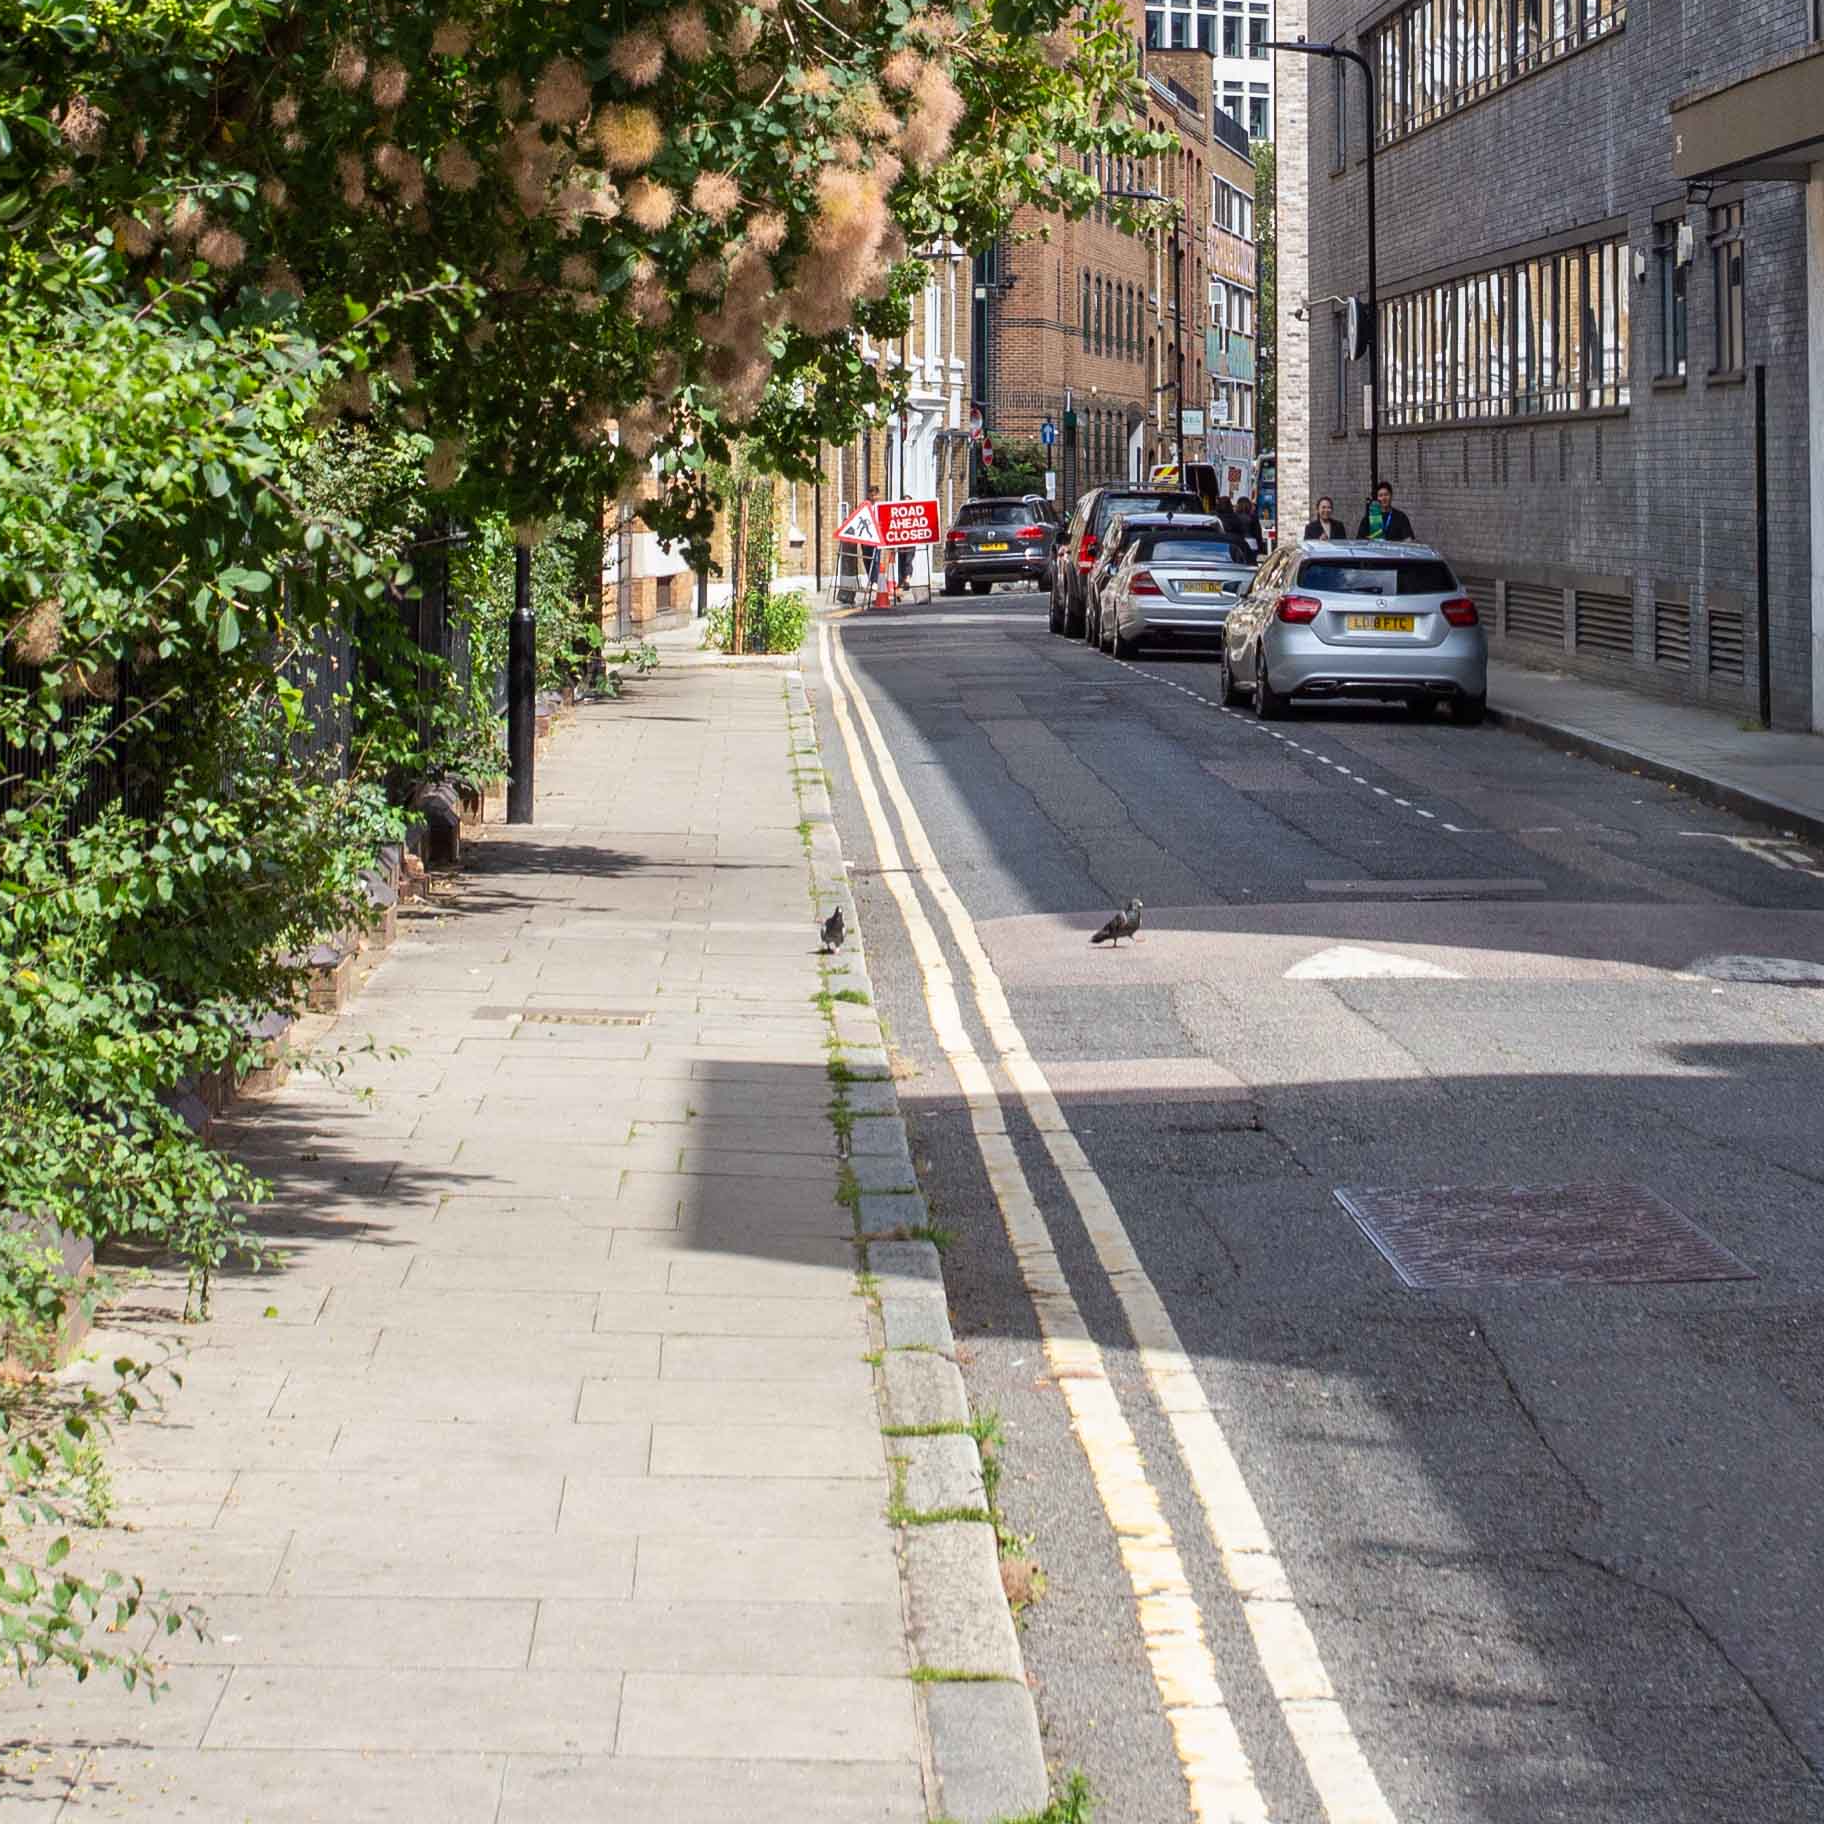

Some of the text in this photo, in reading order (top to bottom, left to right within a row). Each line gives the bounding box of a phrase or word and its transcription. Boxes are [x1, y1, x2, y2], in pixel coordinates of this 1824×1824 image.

[890, 505, 925, 518] ROAD
[889, 517, 928, 530] AHEAD
[886, 529, 933, 542] CLOSED
